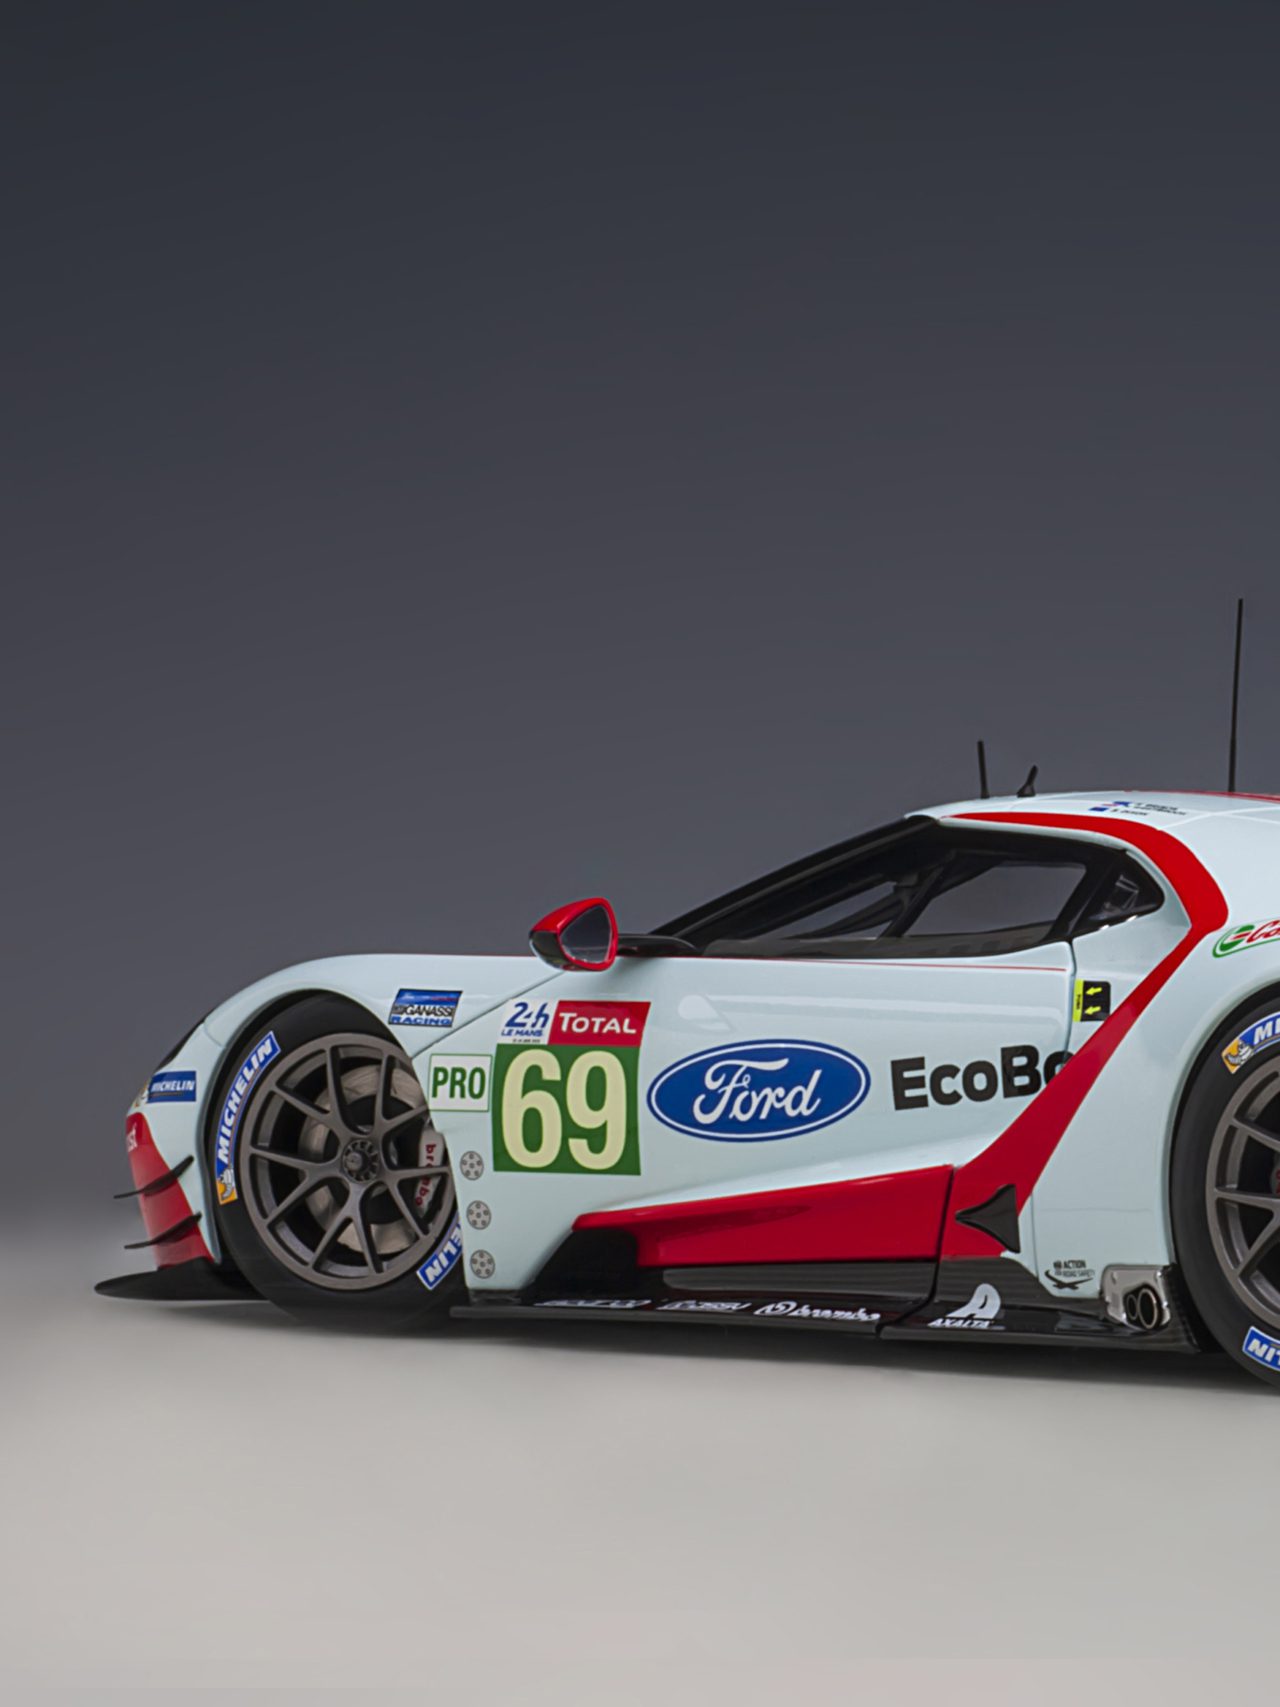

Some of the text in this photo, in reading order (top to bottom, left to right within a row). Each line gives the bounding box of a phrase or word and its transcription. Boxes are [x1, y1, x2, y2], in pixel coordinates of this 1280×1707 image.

[151, 1080, 196, 1093] MICHELIN
[218, 1039, 274, 1165] MICHELIN
[431, 1066, 486, 1099] PRO
[692, 1057, 823, 1124] Ford
[502, 1049, 627, 1170] 69
[927, 1318, 991, 1328] AXALTA
